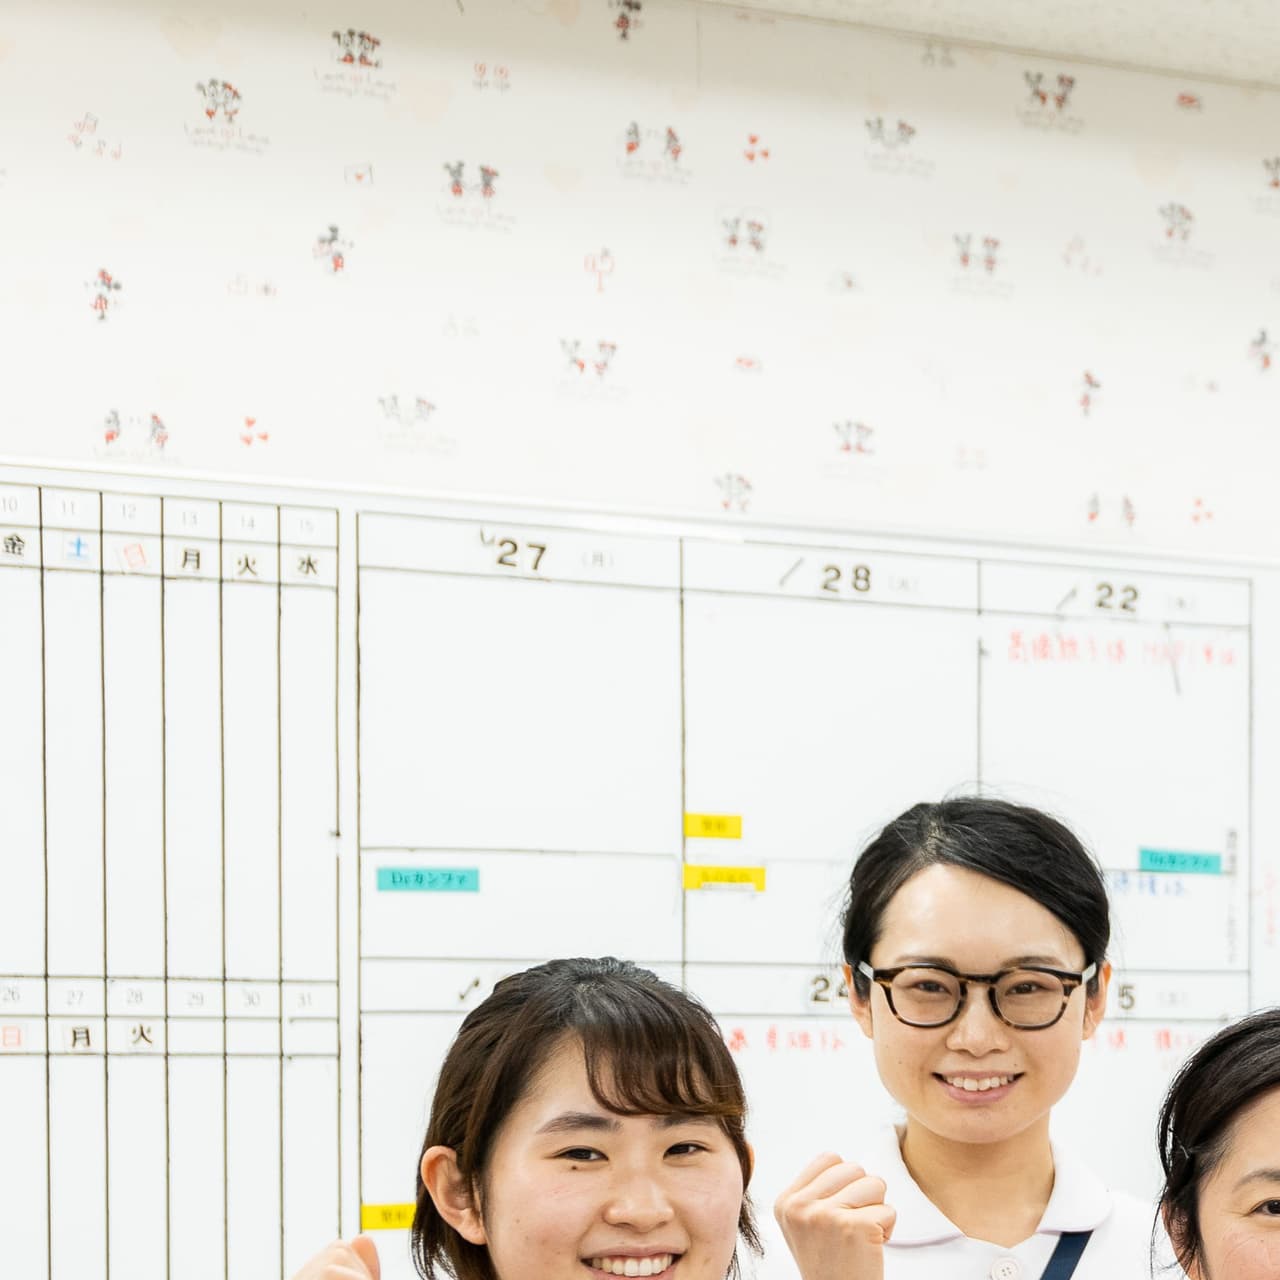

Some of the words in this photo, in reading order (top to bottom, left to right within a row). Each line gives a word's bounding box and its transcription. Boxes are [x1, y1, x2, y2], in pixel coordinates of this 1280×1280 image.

[122, 505, 136, 520] 12
[3, 534, 25, 556] 金
[67, 536, 89, 558] 土
[124, 543, 146, 568] 日
[182, 549, 201, 570] 月
[237, 554, 258, 576] 火
[298, 555, 318, 576] 水
[496, 538, 547, 571] 27
[822, 564, 872, 593] 28
[1095, 581, 1139, 611] 22
[3, 1026, 21, 1047] 日
[71, 1026, 91, 1048] 月
[132, 1024, 152, 1045] 火
